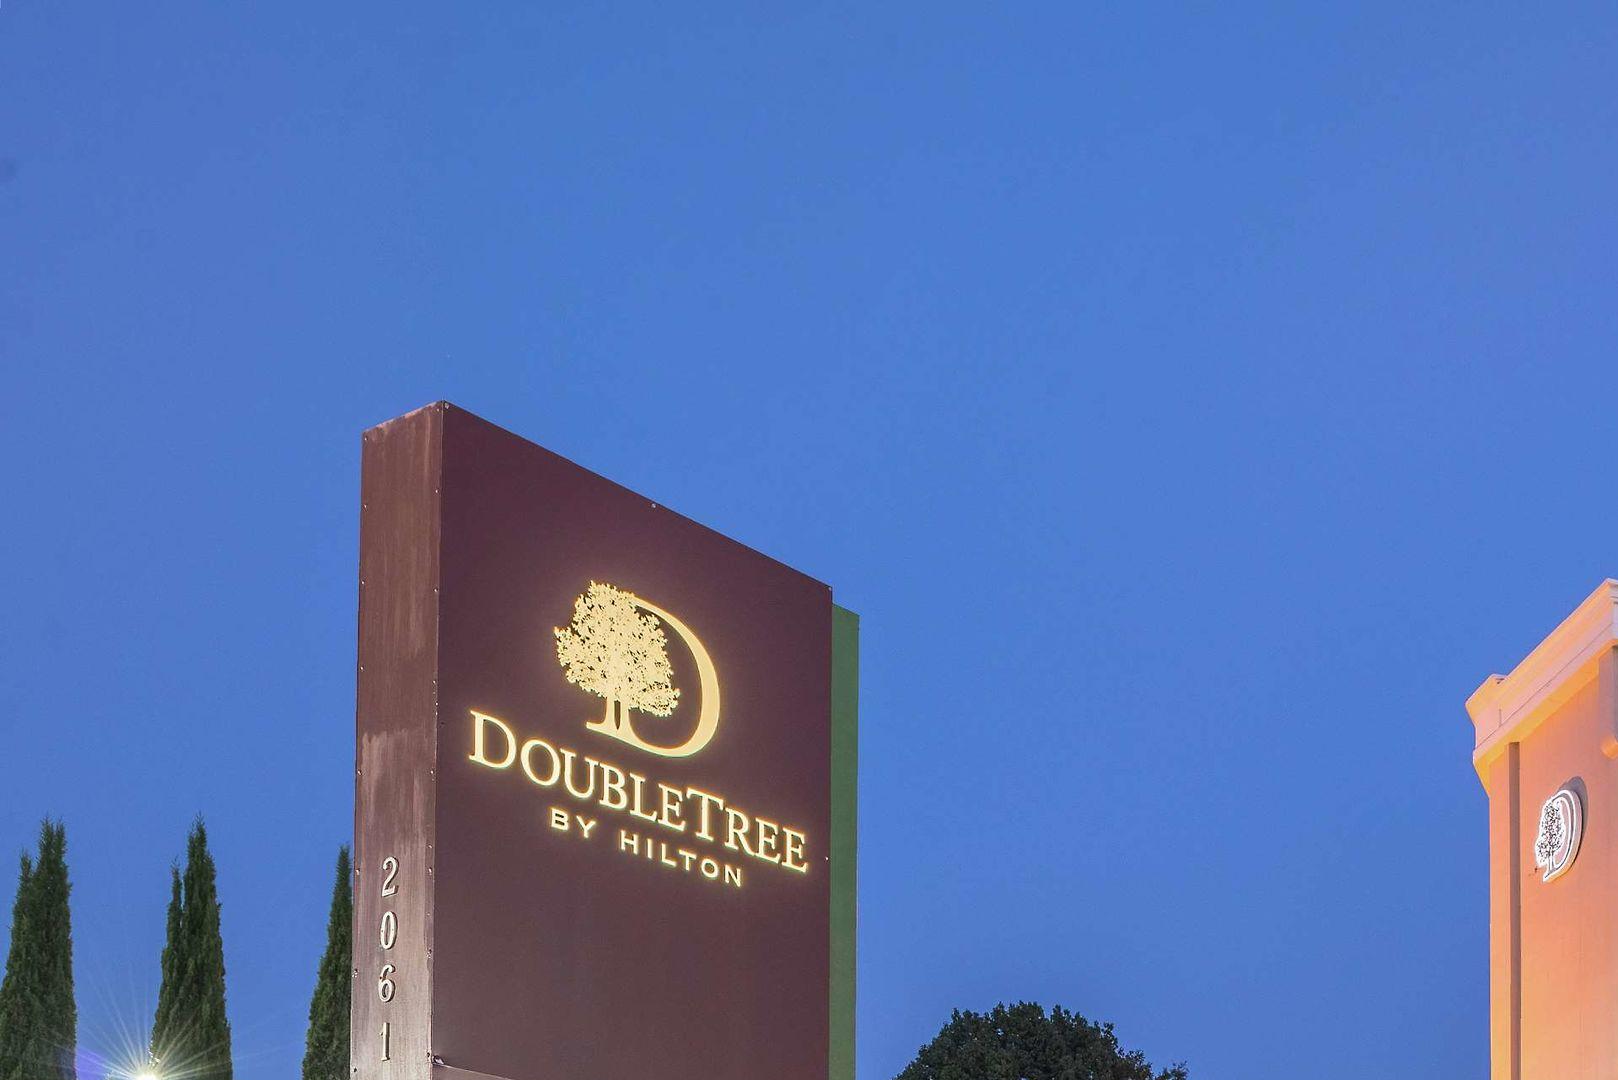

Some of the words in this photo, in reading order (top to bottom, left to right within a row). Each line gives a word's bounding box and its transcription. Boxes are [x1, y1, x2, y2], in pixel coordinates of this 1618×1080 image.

[468, 709, 809, 874] DOUBLETREE
[550, 806, 597, 840] BY
[620, 829, 743, 889] HILTON
[377, 855, 400, 1062] 2061
